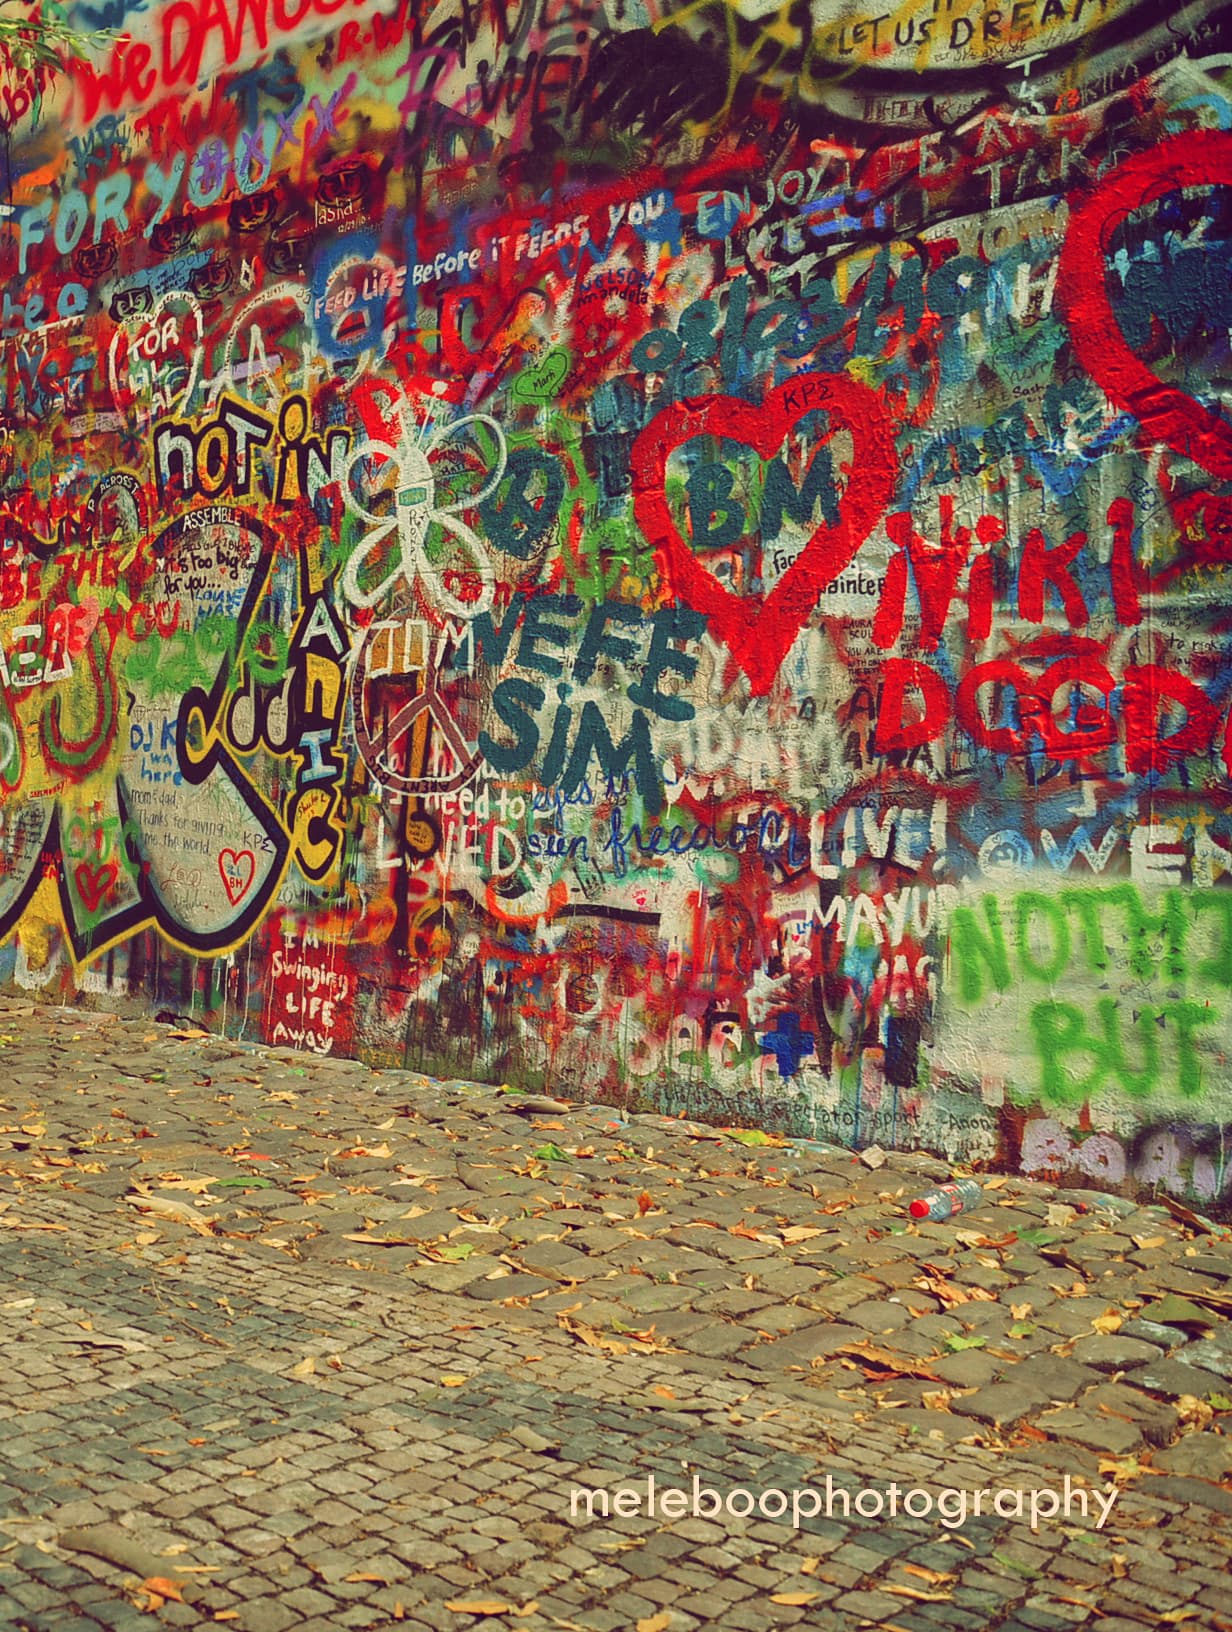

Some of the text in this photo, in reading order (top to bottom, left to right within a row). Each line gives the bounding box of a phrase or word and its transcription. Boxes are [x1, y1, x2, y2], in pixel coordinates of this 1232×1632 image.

[838, 14, 890, 55] LET
[894, 20, 937, 46] US
[315, 286, 357, 319] FEED
[413, 247, 482, 286] Before
[183, 507, 243, 532] ASSEMBLE
[496, 787, 526, 822] to
[285, 996, 335, 1028] LIFE
[1030, 996, 1218, 1102] BUT
